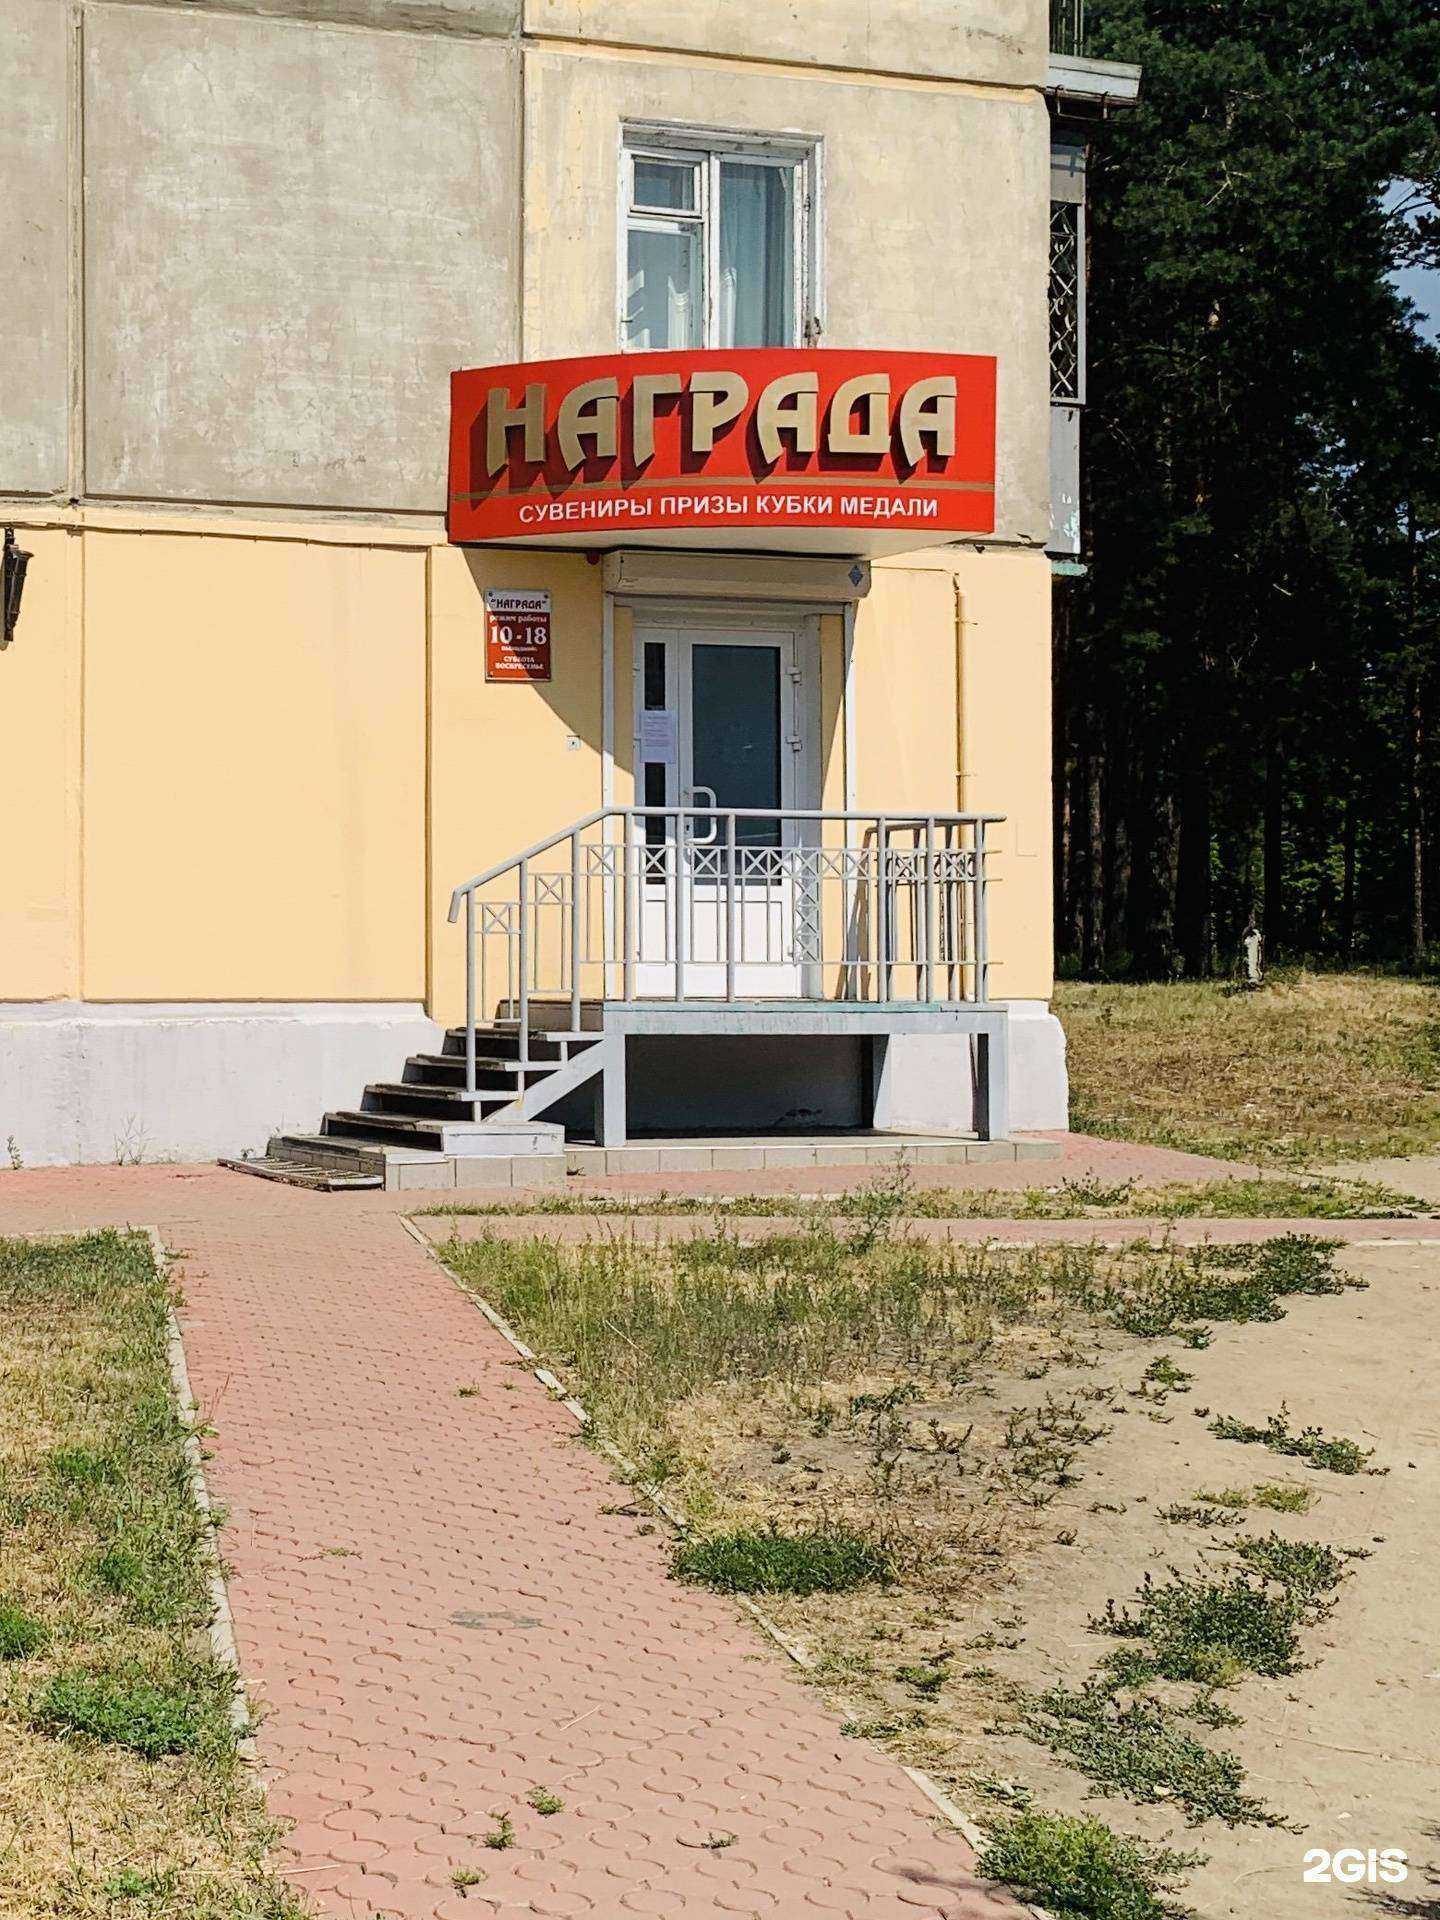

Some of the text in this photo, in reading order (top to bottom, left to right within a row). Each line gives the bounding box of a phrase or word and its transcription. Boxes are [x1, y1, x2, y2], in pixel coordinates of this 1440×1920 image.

[485, 370, 957, 478] НАГРАДА
[519, 494, 939, 524] СУВЕНИРЫ ПРИЗЫ КУБКИ МЕДАЛИ
